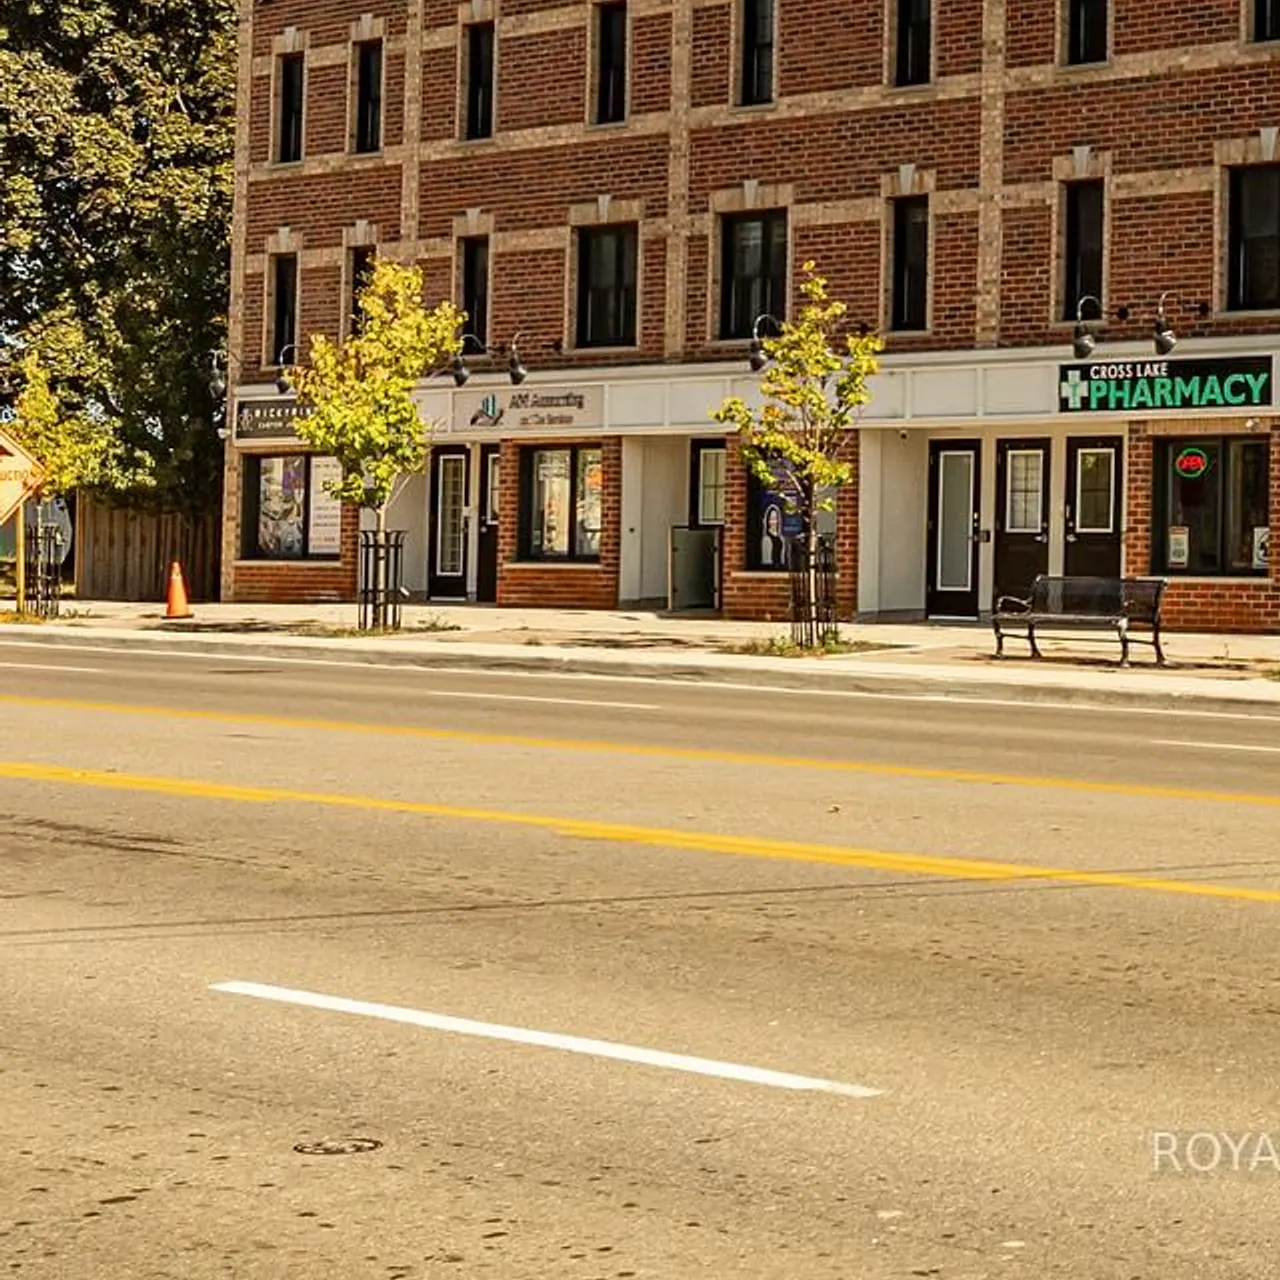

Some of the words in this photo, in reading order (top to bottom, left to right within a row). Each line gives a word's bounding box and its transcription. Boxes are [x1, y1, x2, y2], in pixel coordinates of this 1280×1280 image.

[1089, 364, 1133, 380] CROSS
[1136, 362, 1169, 378] LAKE
[1089, 373, 1268, 410] PHARMACY
